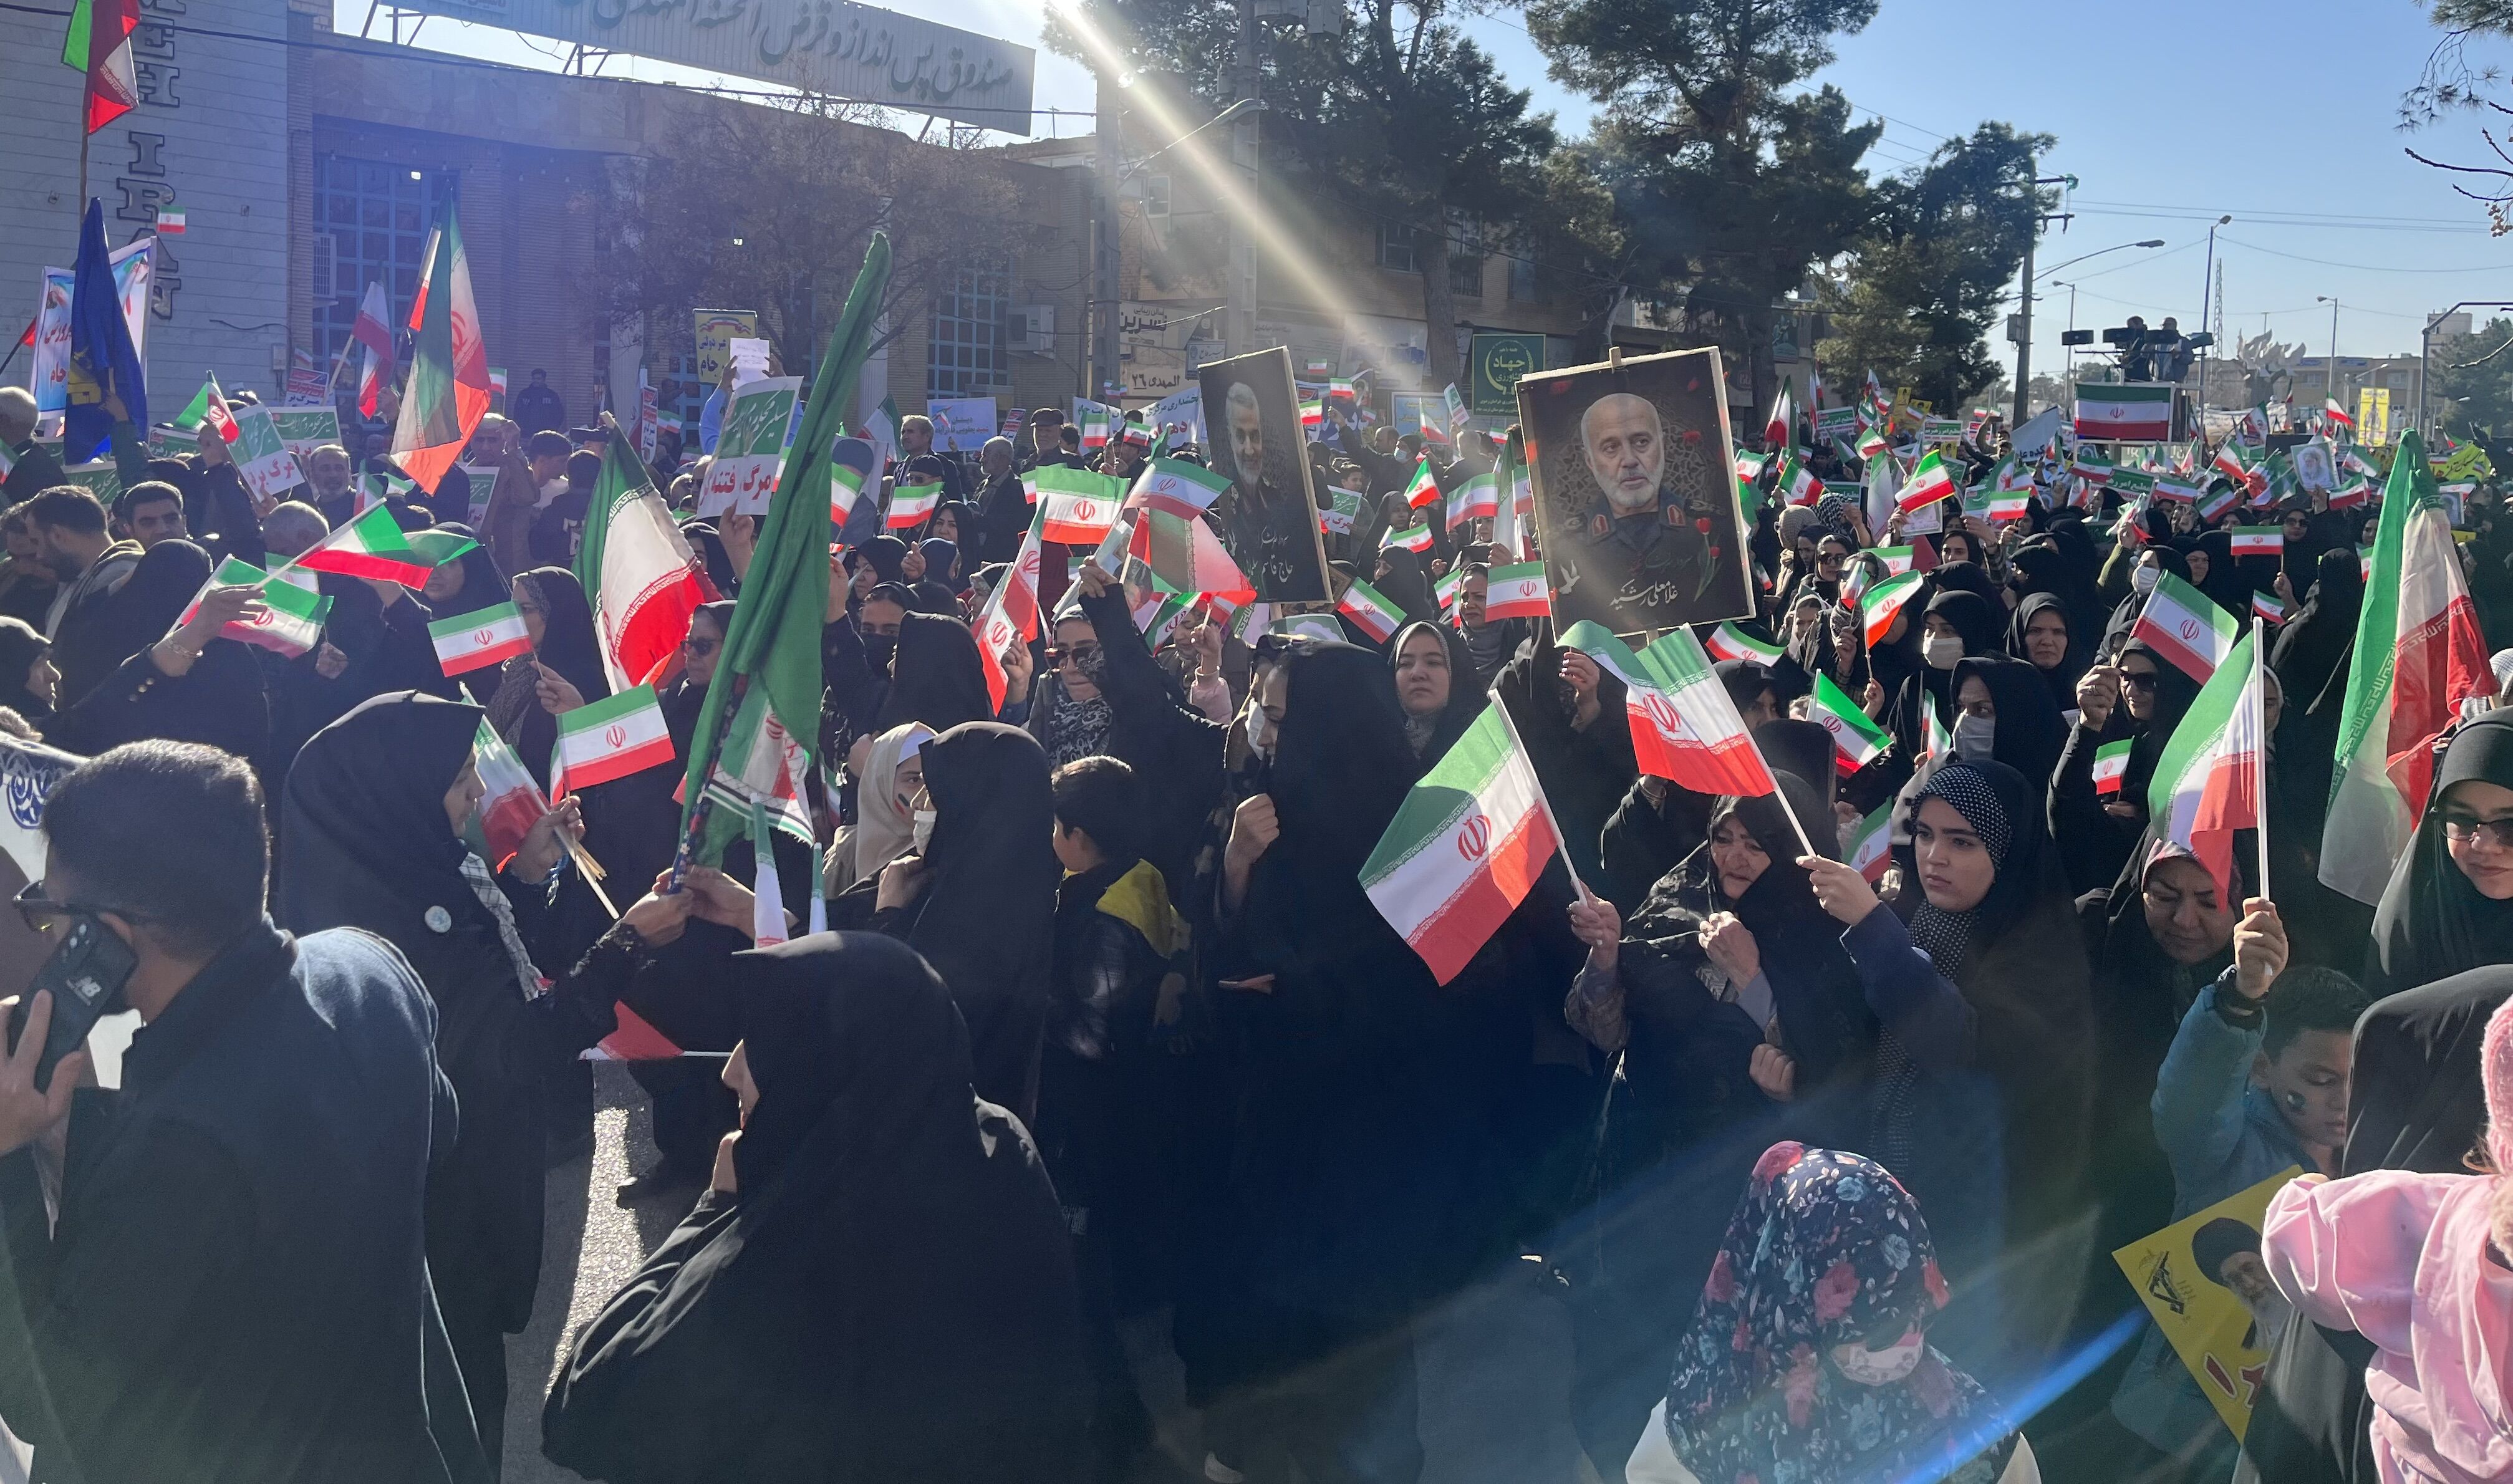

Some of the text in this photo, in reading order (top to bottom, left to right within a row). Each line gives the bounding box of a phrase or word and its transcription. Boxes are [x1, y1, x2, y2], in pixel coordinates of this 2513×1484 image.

[890, 42, 933, 100] پس
[932, 46, 1013, 101] صندوق
[1119, 312, 1167, 334] نسرین
[1493, 355, 1525, 371] جهاد
[743, 464, 771, 500] مرگ
